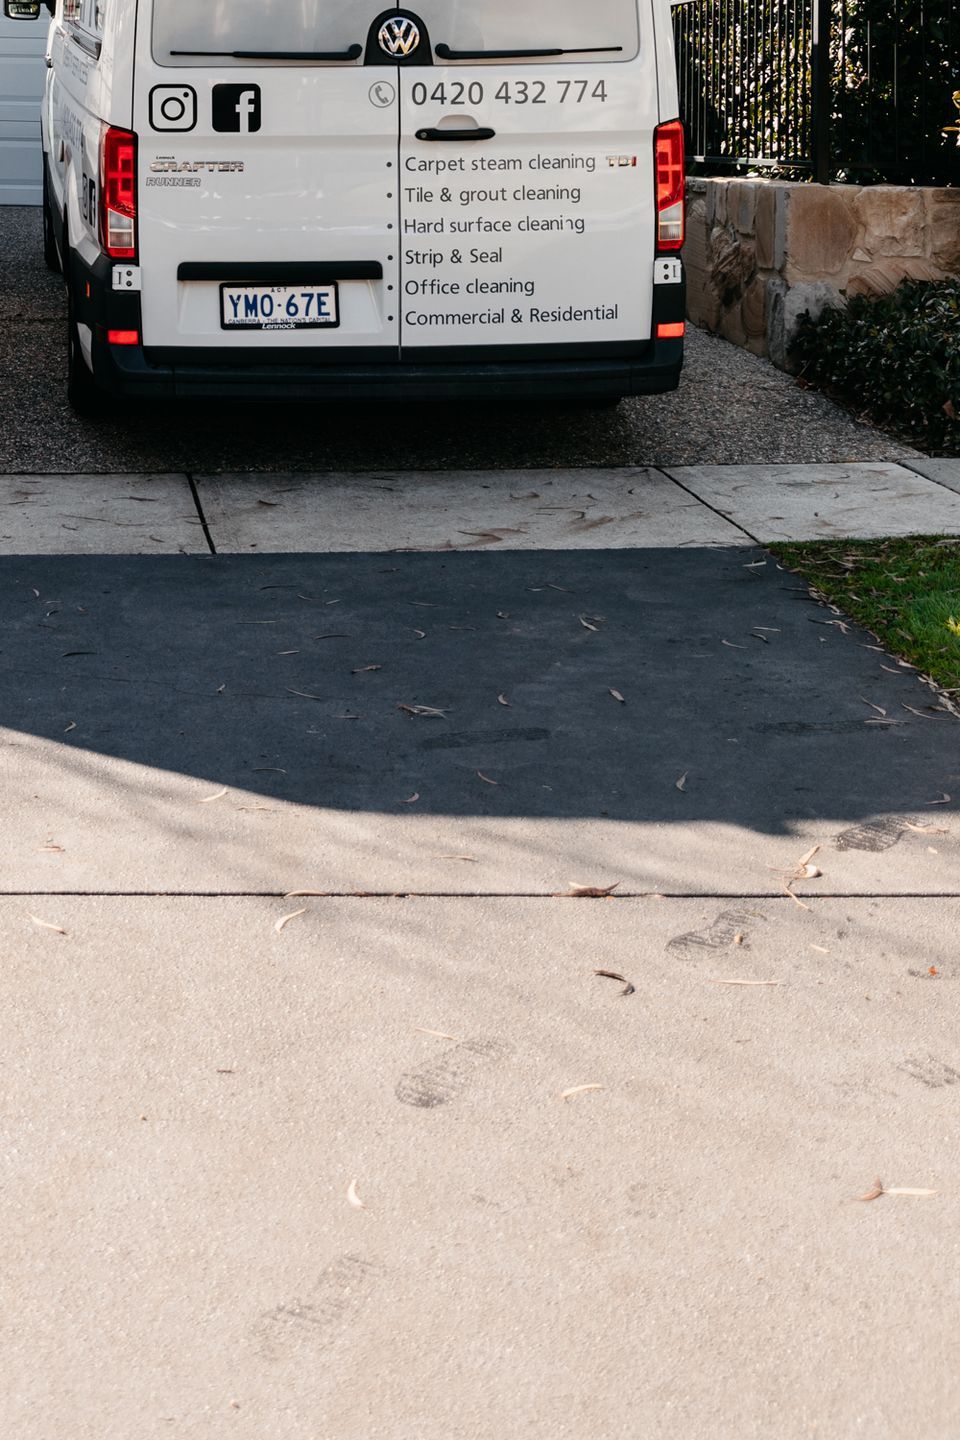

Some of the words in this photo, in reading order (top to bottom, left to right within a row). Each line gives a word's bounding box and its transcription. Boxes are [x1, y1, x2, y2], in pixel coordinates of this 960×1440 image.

[411, 82, 484, 105] 0420
[494, 81, 547, 104] 432
[556, 79, 608, 103] 774
[150, 161, 244, 173] CRAFTER
[405, 156, 465, 175] Carpet
[471, 159, 522, 171] steam
[528, 153, 596, 172] cleaning
[606, 155, 637, 166] TDI
[146, 177, 201, 187] RUNNER
[405, 188, 433, 202] Tile
[440, 188, 452, 202] &
[459, 187, 507, 205] grout
[513, 184, 581, 203] cleaning
[404, 218, 444, 233] Hard
[450, 216, 512, 232] surface
[517, 215, 585, 233] cleaning
[405, 249, 444, 267] Strip
[450, 249, 462, 263] &
[470, 247, 502, 262] Seal
[405, 280, 460, 295] Office
[465, 278, 535, 296] cleaning
[405, 309, 504, 325] Commercial
[511, 308, 522, 323] &
[530, 304, 618, 322] Residential
